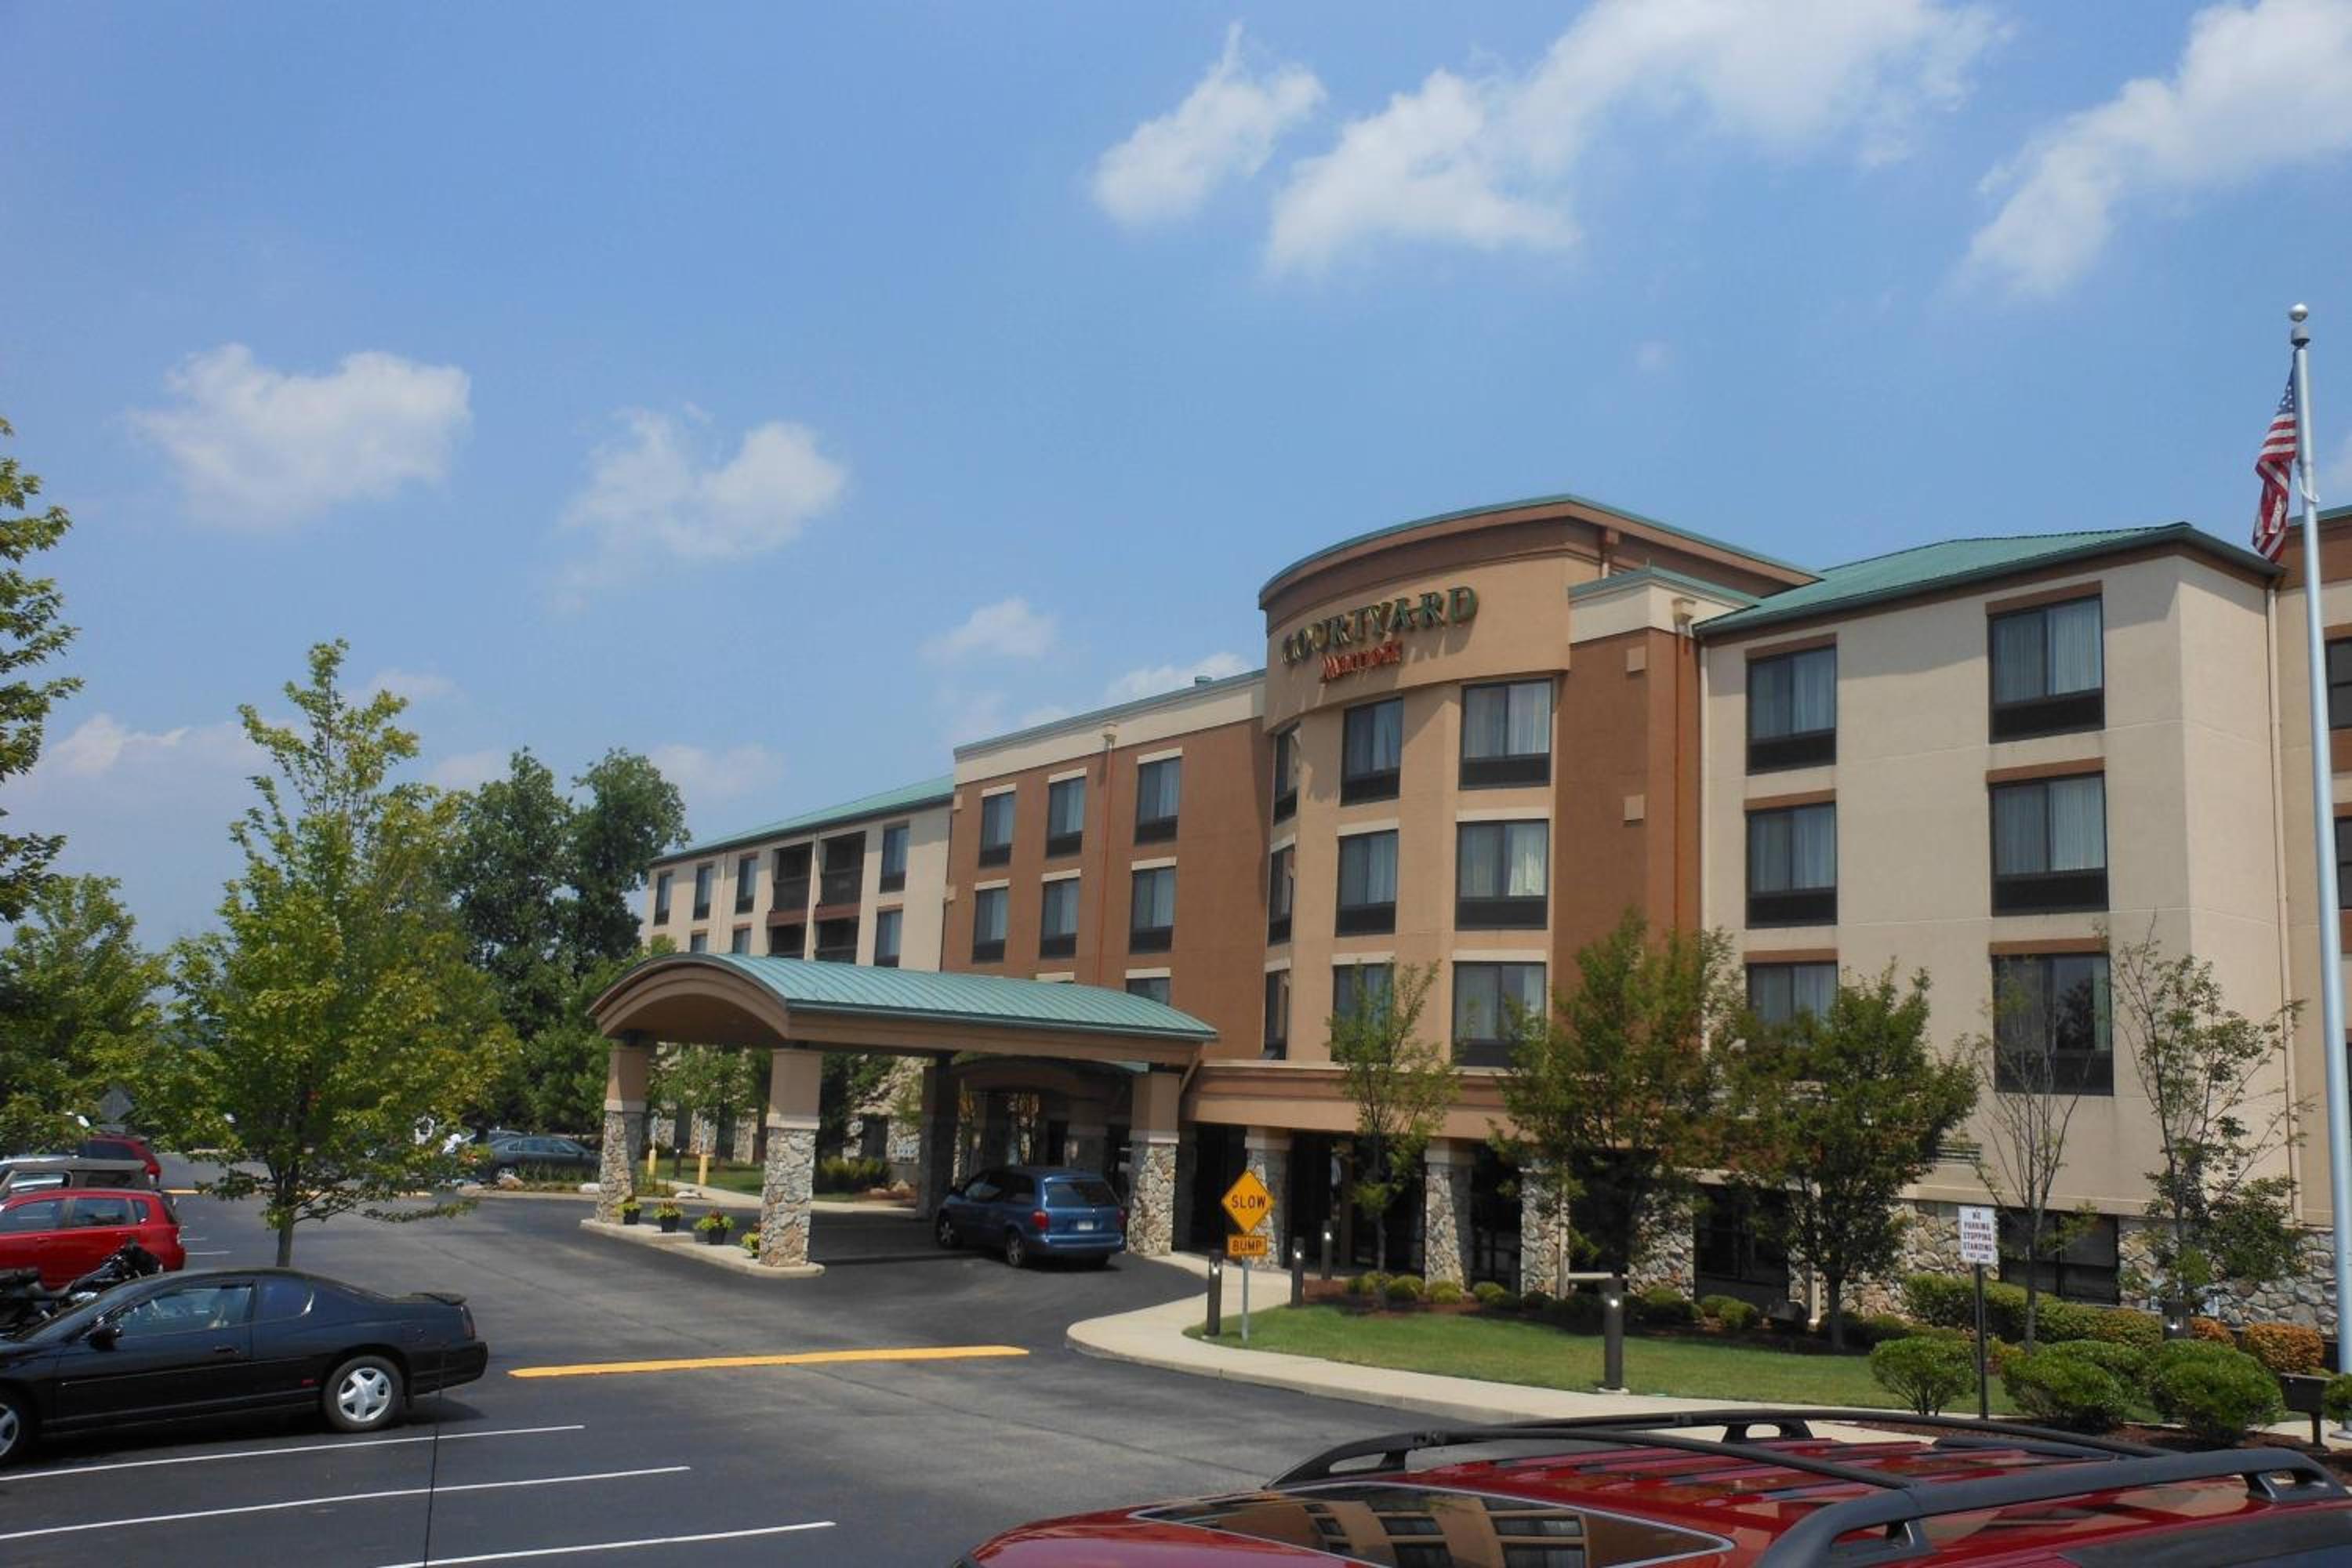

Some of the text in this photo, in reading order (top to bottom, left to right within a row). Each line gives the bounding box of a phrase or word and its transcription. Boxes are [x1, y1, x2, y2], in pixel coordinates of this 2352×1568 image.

[1280, 586, 1479, 665] COURTYARD
[1232, 1194, 1266, 1208] SLOW
[1232, 1240, 1261, 1252] BUMP
[1963, 1242, 1992, 1251] STANDING
